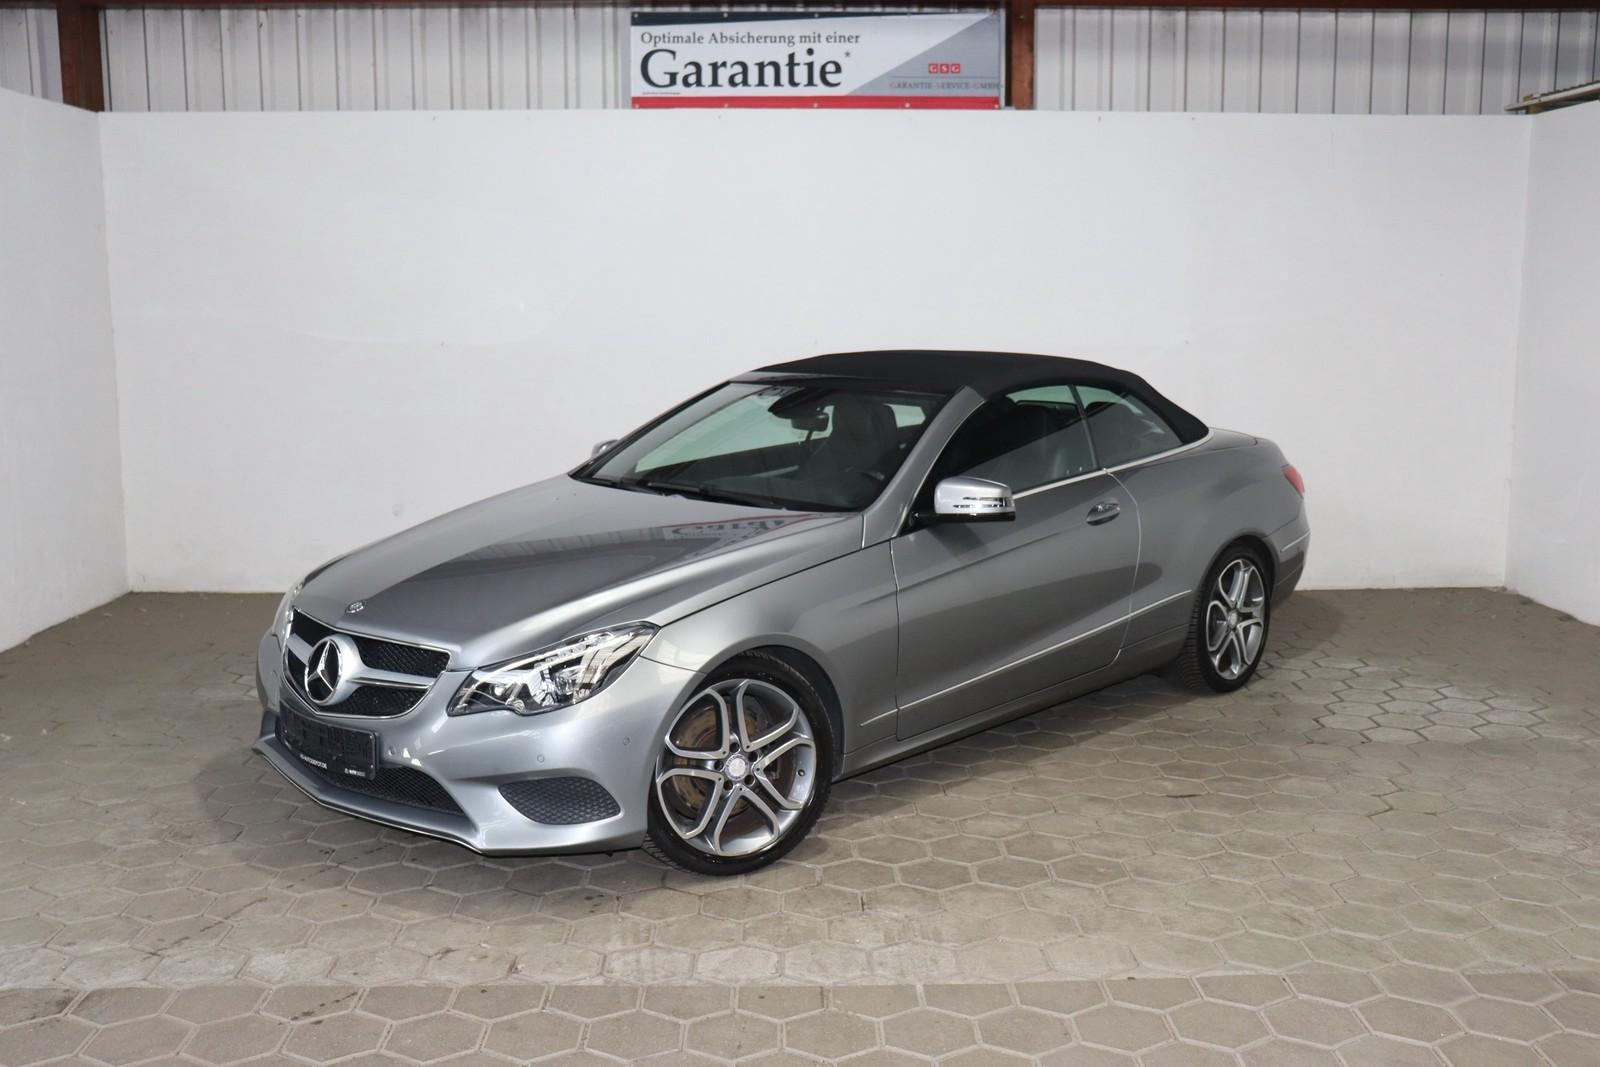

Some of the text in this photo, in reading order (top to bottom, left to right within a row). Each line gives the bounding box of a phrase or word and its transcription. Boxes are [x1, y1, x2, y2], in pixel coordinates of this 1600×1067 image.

[640, 31, 861, 47] Optimale Absicherung mit einer
[928, 63, 961, 74] GSG
